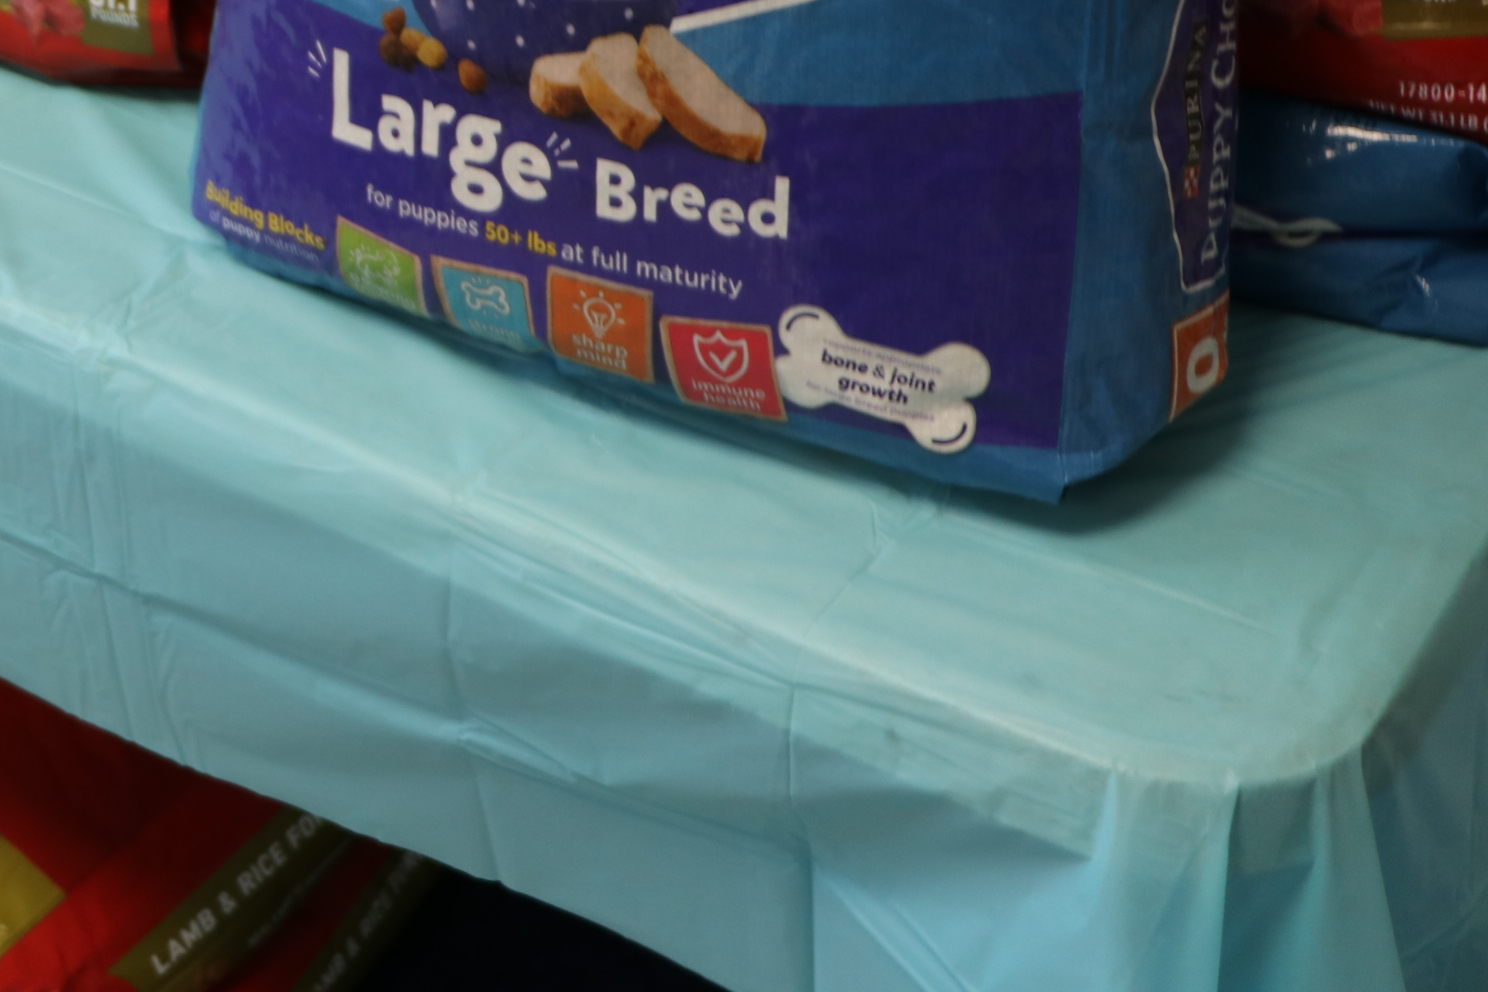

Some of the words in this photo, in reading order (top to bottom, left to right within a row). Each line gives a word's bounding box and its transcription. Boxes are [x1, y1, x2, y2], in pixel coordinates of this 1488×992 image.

[89, 5, 140, 30] POUNDS
[1183, 24, 1208, 162] PURINA
[331, 46, 554, 214] Large
[594, 158, 791, 240] Breed
[1200, 100, 1232, 264] PUPPY
[205, 180, 267, 230] Building
[267, 213, 326, 251] Blocks
[221, 215, 261, 247] puppy
[263, 233, 320, 263] nutrition
[366, 183, 393, 210] for
[398, 196, 479, 238] puppies
[484, 220, 523, 247] 50+
[527, 230, 557, 258] lbs
[561, 241, 584, 263] at
[591, 245, 629, 274] full
[636, 256, 743, 301] maturity
[572, 330, 630, 361] sharp
[575, 345, 628, 372] mind
[689, 377, 767, 402] immune
[821, 347, 870, 374] bone
[872, 363, 887, 380] &
[889, 366, 937, 395] joint
[837, 375, 909, 405] growth
[703, 390, 762, 412] health
[149, 906, 216, 976] LAMB
[216, 892, 238, 913] &
[236, 841, 290, 899] RICE
